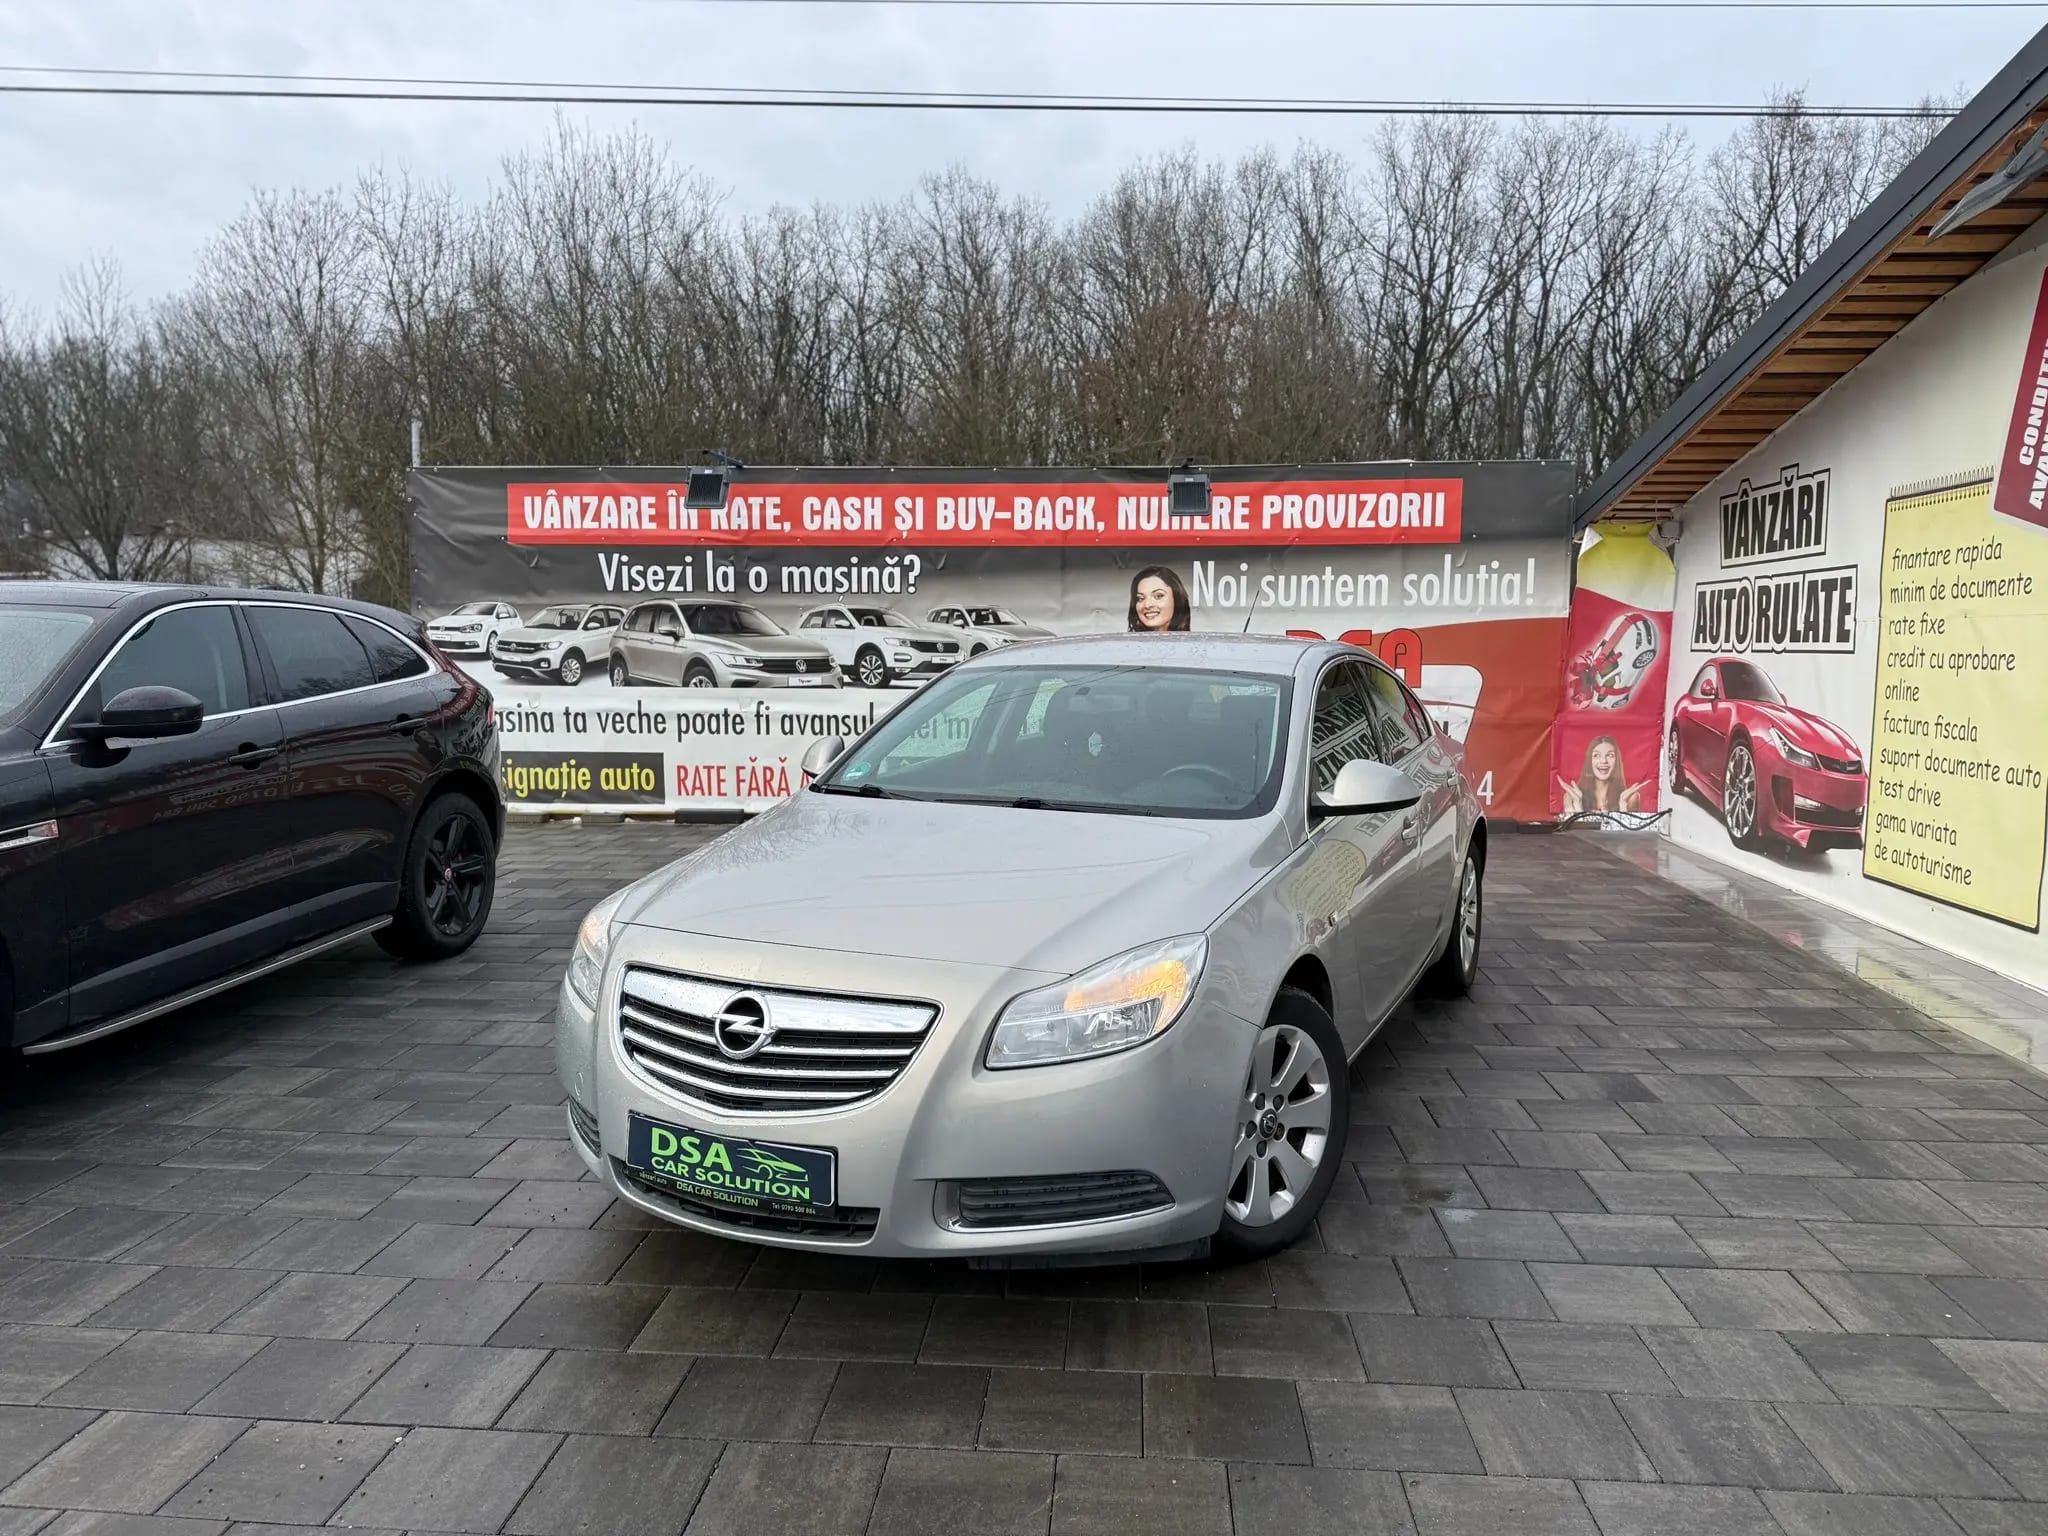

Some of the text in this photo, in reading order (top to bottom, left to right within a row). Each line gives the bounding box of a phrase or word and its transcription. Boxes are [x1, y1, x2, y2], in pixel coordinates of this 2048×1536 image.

[524, 489, 657, 529] VÂNZARE
[667, 489, 699, 530] ÎN
[803, 496, 882, 531] CASH
[894, 496, 924, 539] ȘI
[936, 496, 1105, 533] BUY-BACK,
[1262, 492, 1445, 529] PROVIZORII
[1723, 474, 1826, 560] VÂNZĂRI
[1892, 535, 2002, 571] finantare rapida
[597, 550, 921, 602] Visezi la o mașină?
[1193, 554, 1536, 615] Noi suntem soluția!
[1890, 572, 2033, 603] minim de documente
[1694, 576, 1853, 645] AUTO RULATE
[1888, 612, 1946, 636] rate fixe
[1887, 645, 2016, 677] credit cu aprobare
[1885, 678, 1920, 702] online
[494, 703, 554, 733] asina
[563, 706, 588, 733] ta
[597, 700, 667, 734] veche
[677, 708, 745, 742] poate
[754, 700, 771, 735] fi
[781, 702, 874, 736] avansul
[1883, 710, 1978, 742] factura fiscala
[600, 762, 655, 791] auto
[676, 764, 727, 796] RATE
[736, 756, 792, 797] FĂRĂ
[1880, 747, 2042, 789] suport documente auto
[1879, 776, 1941, 807] test drive
[1876, 811, 1957, 846] gama variata
[1874, 838, 1972, 886] de autoturisme
[651, 1127, 733, 1172] DSA
[651, 1156, 810, 1200] CAR SOLUTION
[676, 1181, 759, 1207] DSA CAR SOLUTION
